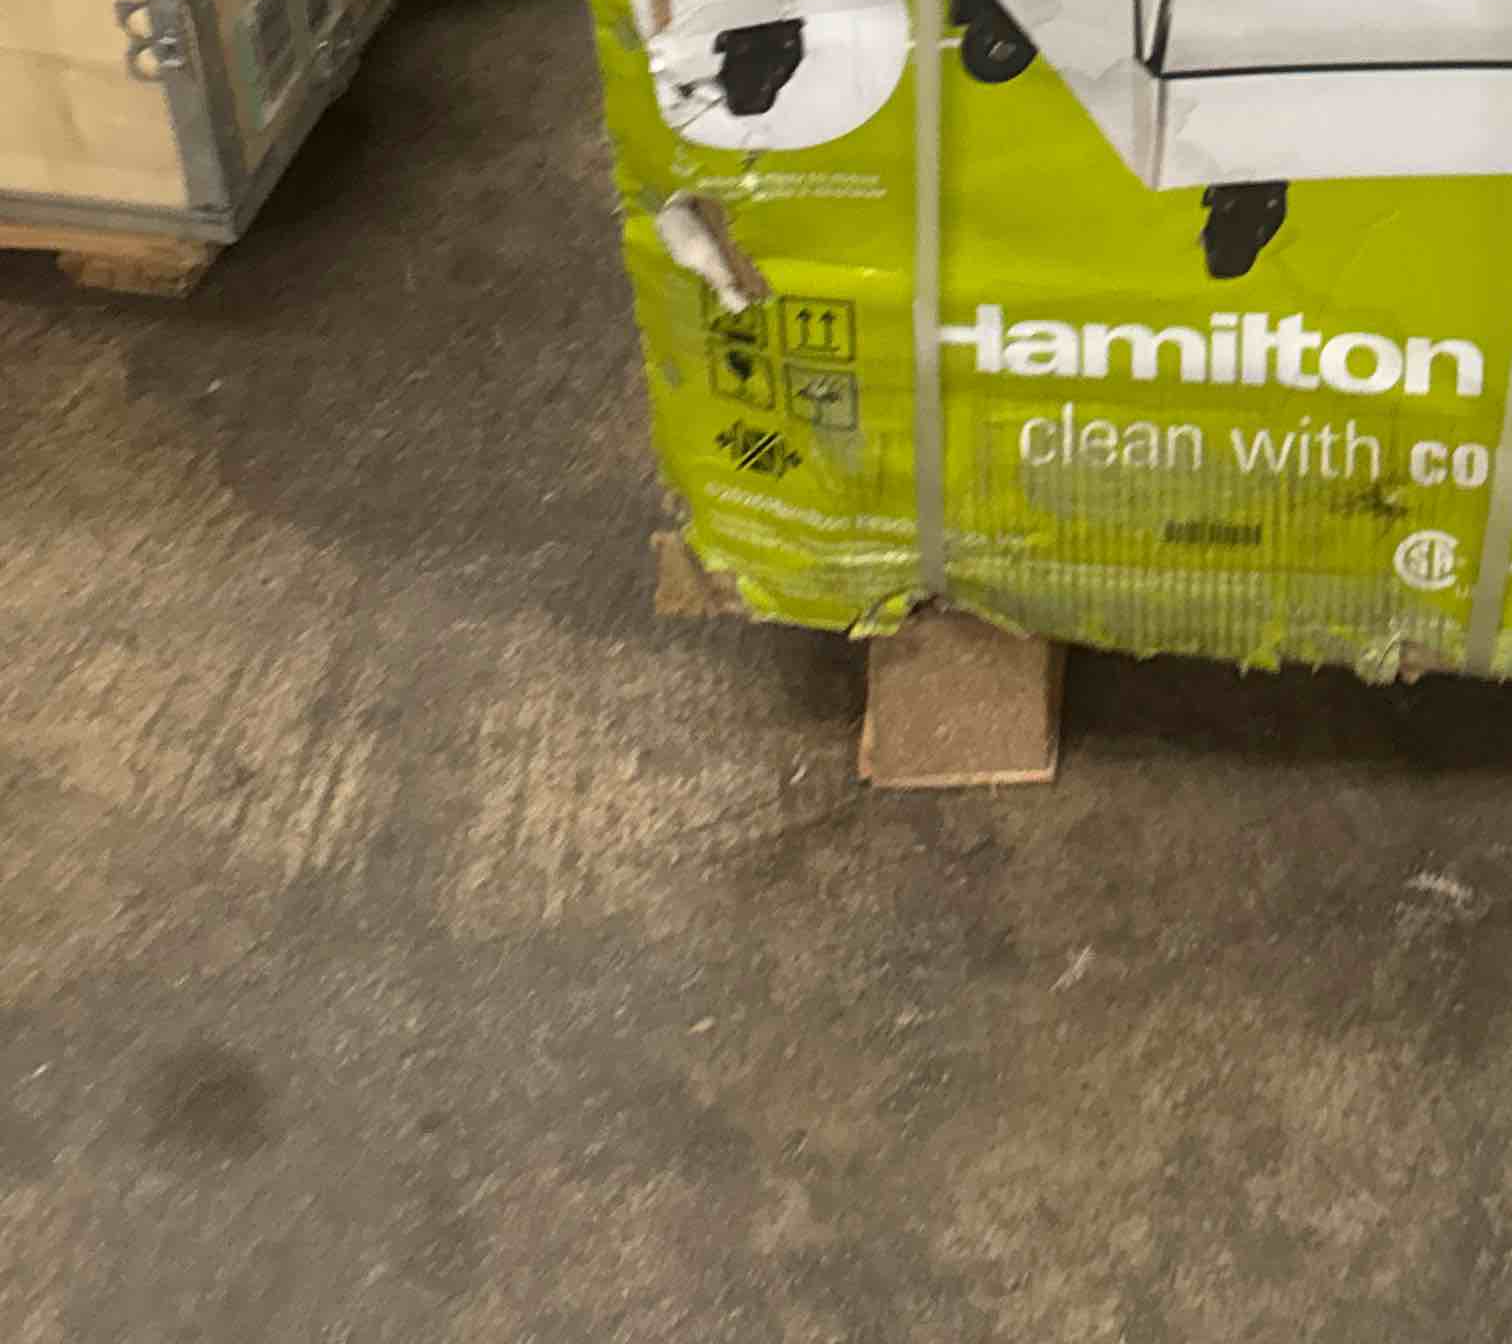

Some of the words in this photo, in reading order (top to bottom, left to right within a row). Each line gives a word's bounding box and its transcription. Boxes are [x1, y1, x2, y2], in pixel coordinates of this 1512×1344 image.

[936, 303, 1484, 398] Hamilton
[1018, 401, 1205, 472] clean
[1230, 414, 1382, 484] with
